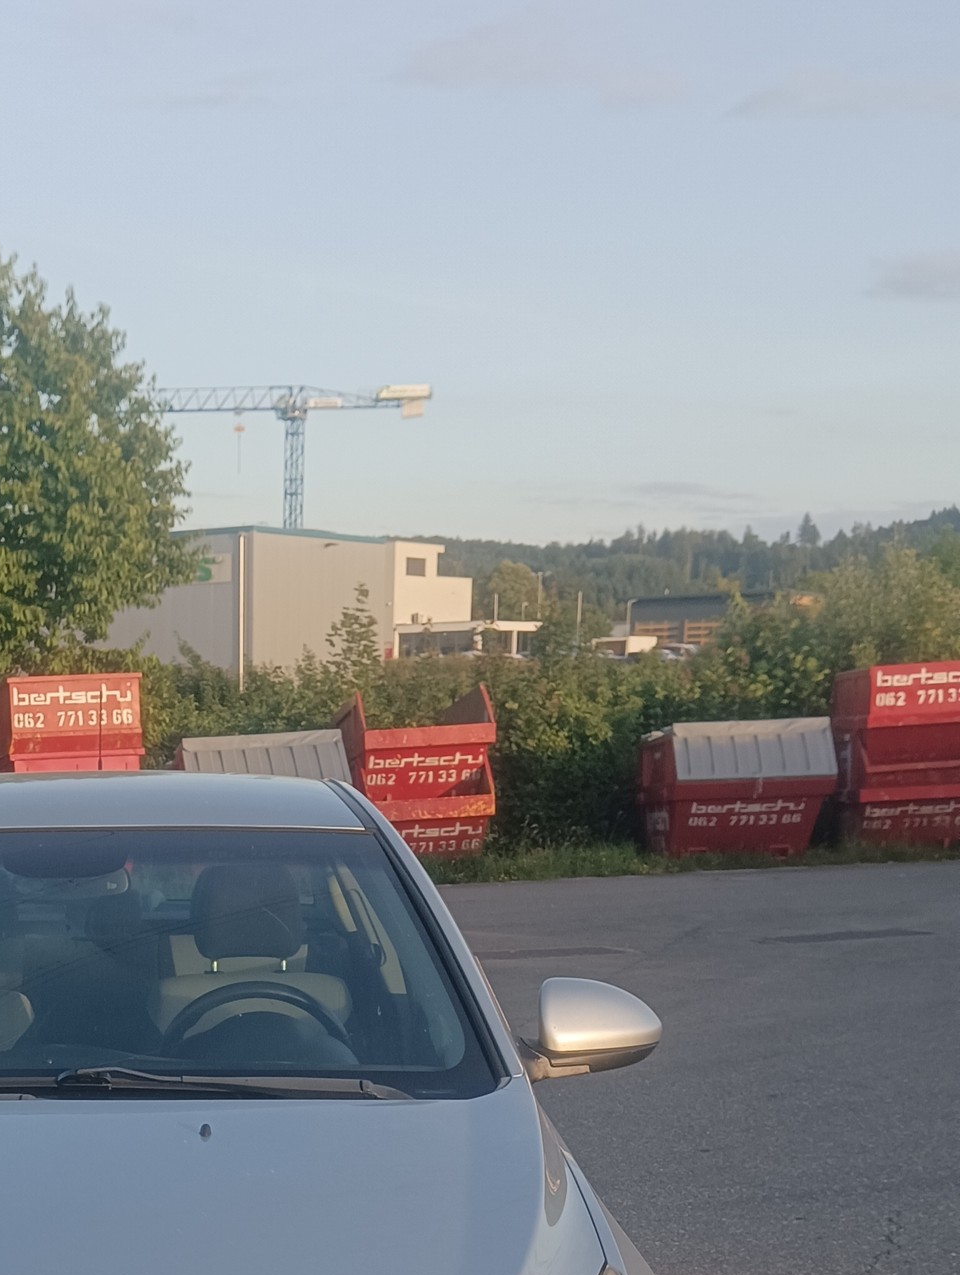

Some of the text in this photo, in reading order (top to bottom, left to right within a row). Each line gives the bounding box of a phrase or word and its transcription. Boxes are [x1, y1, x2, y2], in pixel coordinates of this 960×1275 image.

[876, 667, 960, 687] bertsc
[13, 682, 132, 706] bertschi
[875, 688, 960, 707] 062 771 3
[14, 709, 133, 728] 062 771 33 66
[368, 749, 484, 769] bertschi
[367, 773, 396, 786] 062
[408, 770, 434, 784] 771
[438, 769, 456, 782] 33
[691, 798, 807, 814] bertschi
[398, 820, 482, 838] rtschi
[688, 816, 718, 827] 062
[438, 840, 456, 851] 33
